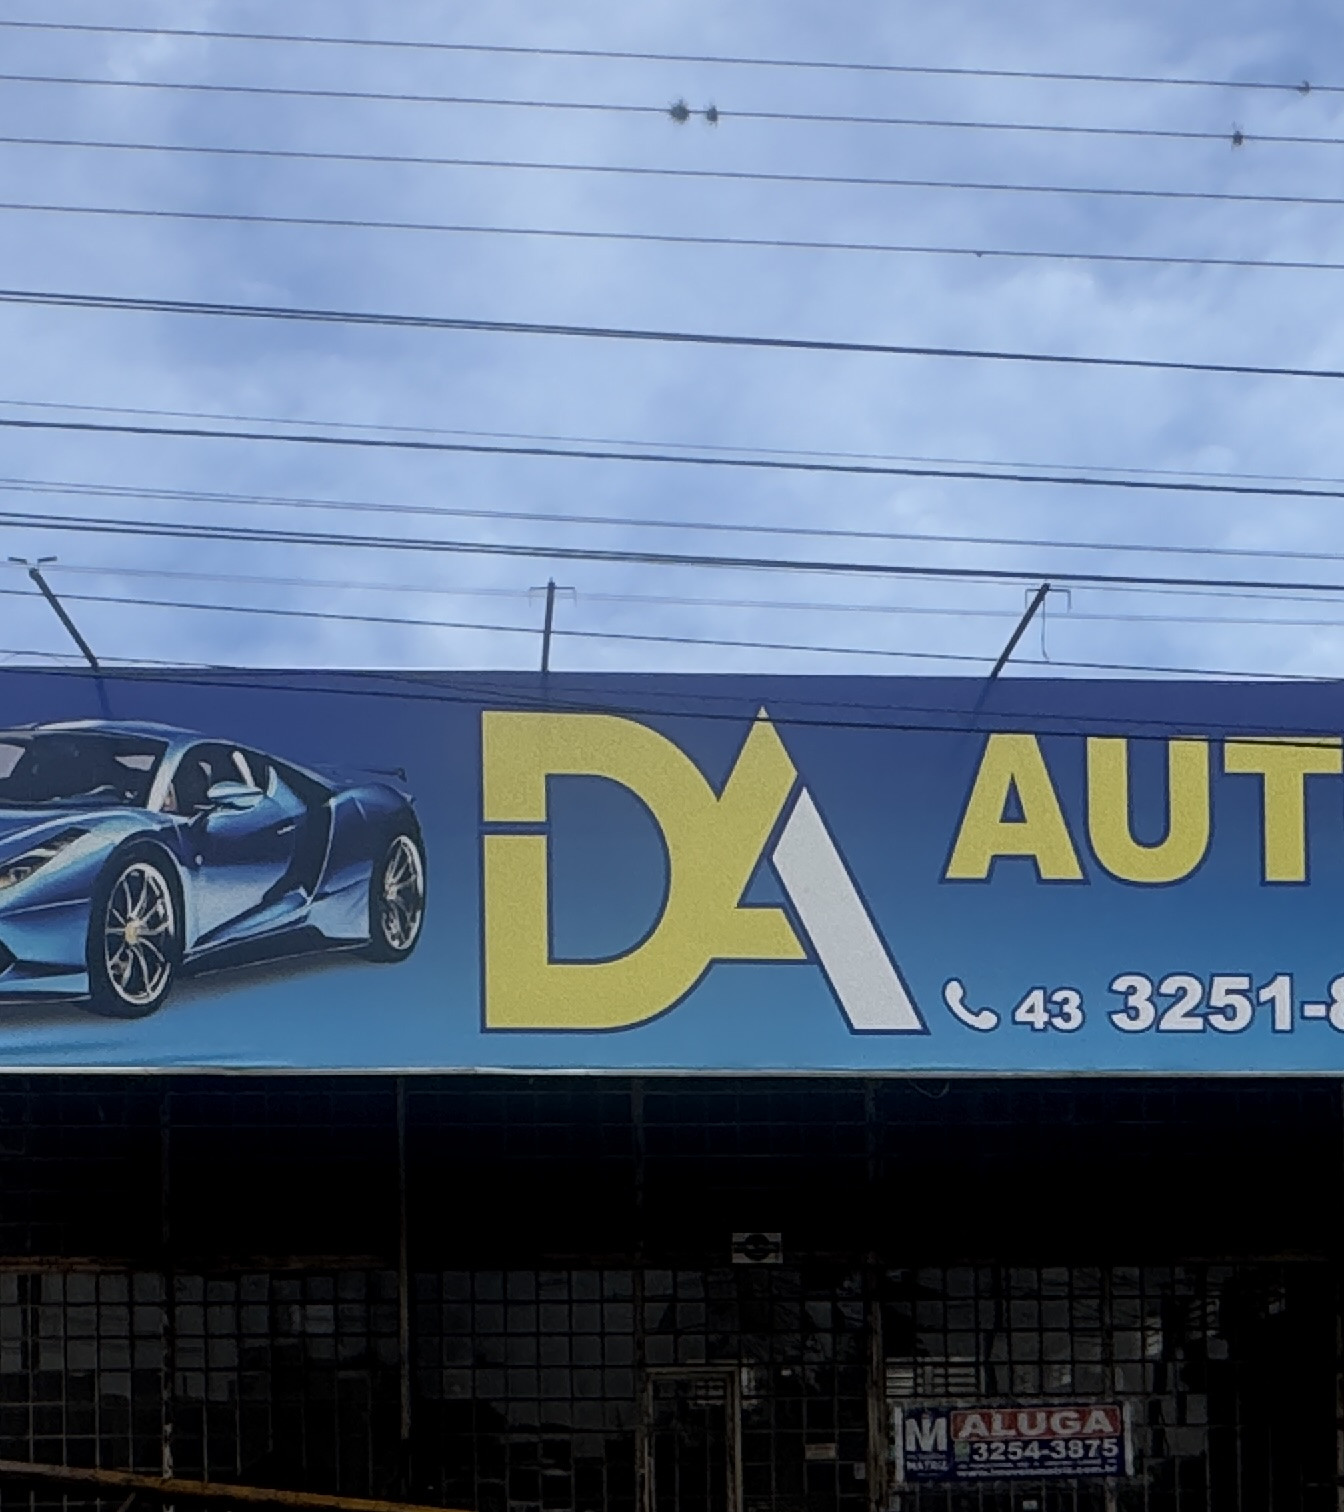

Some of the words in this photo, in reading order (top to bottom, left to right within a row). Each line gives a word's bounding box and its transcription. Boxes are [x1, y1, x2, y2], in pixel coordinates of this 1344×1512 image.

[481, 706, 928, 1031] DA
[1013, 988, 1084, 1032] 43
[959, 1411, 1113, 1438] ALUGA
[972, 1439, 1119, 1461] 3254-3875
